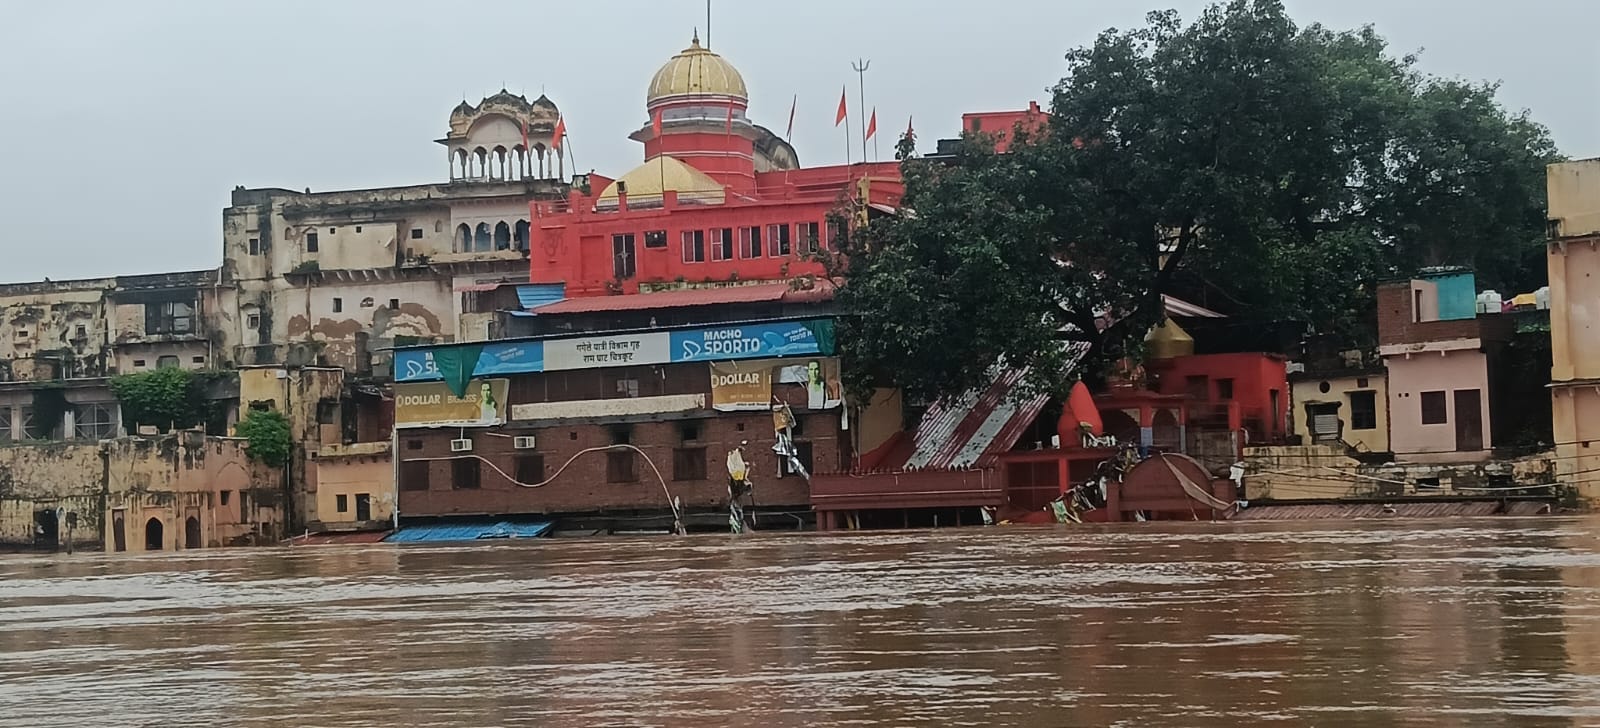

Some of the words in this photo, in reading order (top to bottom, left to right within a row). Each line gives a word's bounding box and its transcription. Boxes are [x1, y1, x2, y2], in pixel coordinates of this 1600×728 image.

[704, 329, 741, 340] MACHO
[704, 338, 760, 355] SPORTO
[720, 373, 759, 385] DOLLAR
[405, 395, 440, 405] DOLLAR
